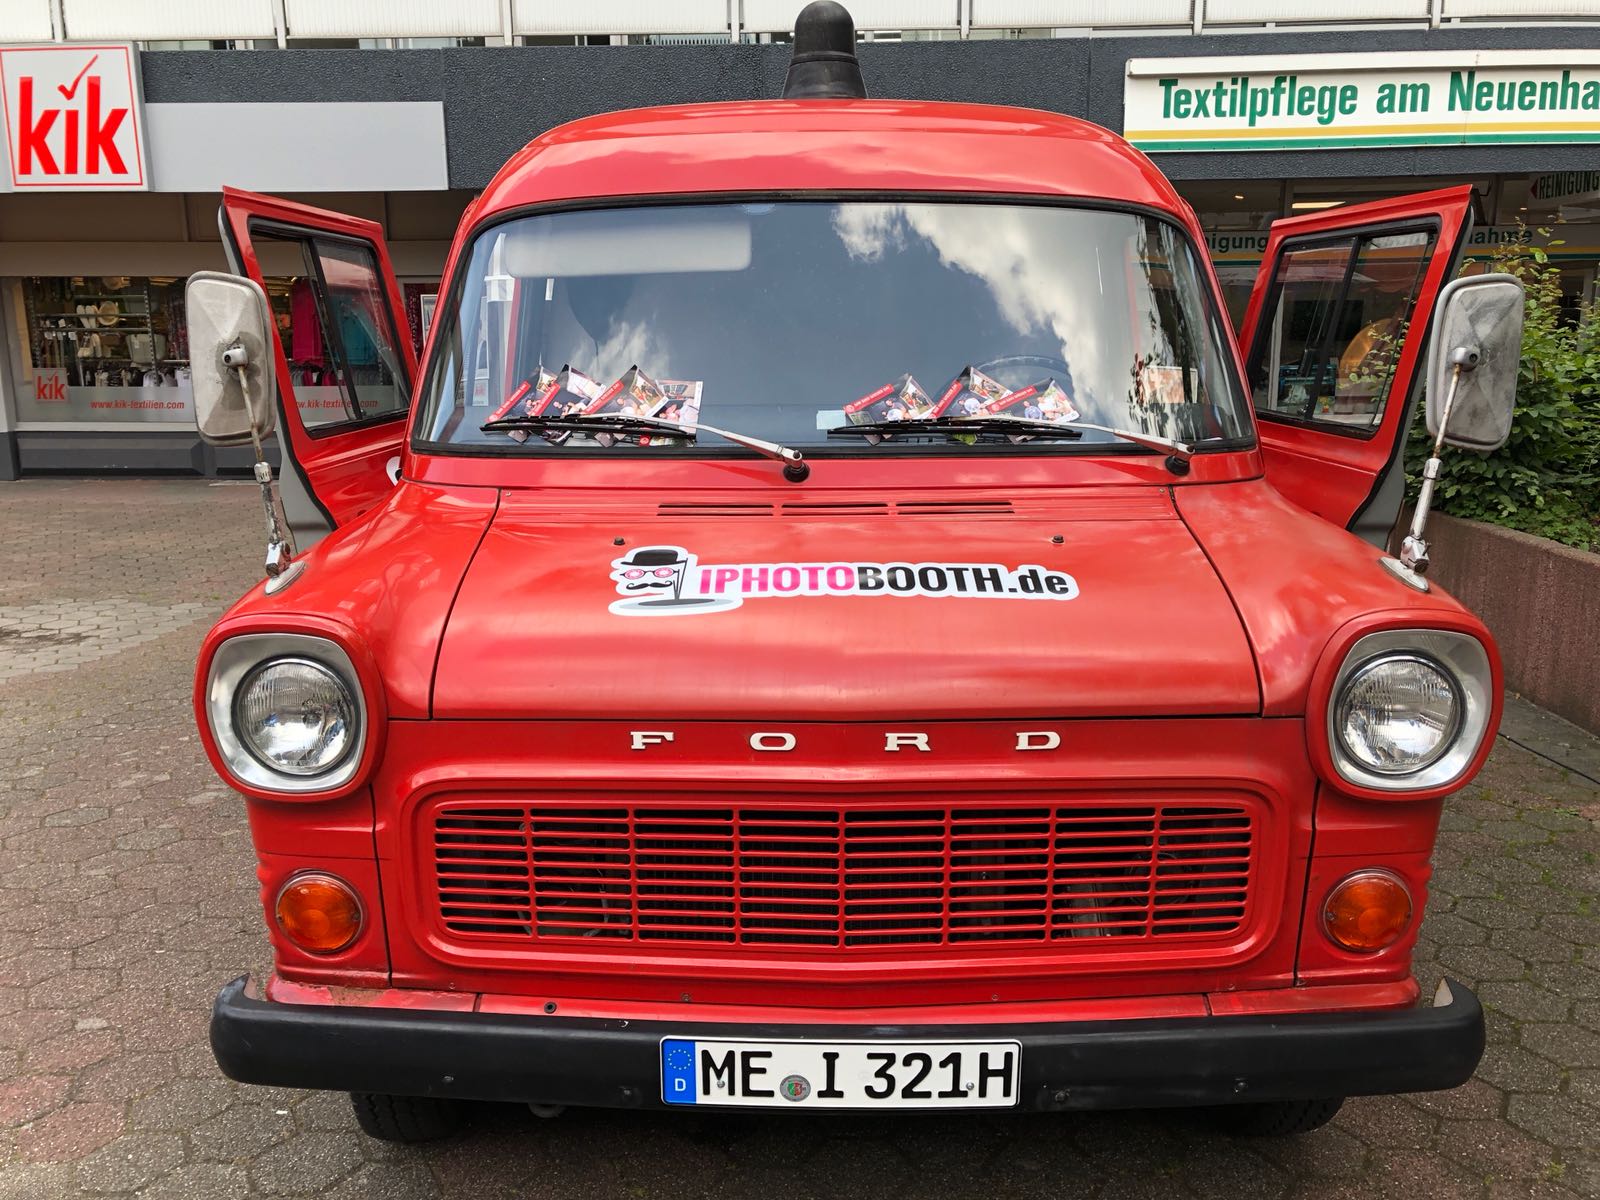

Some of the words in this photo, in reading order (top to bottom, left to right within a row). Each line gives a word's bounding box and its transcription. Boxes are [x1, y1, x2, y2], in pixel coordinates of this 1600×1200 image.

[18, 54, 129, 175] kik
[1158, 75, 1359, 127] Textilpflege
[1376, 82, 1431, 114] am
[1539, 171, 1600, 201] REINIGUNG
[36, 374, 66, 400] kik
[90, 400, 185, 410] www.kik-textilien.com
[699, 563, 1069, 595] IPHOTOBOOTH.de
[674, 1078, 686, 1092] D
[701, 1049, 775, 1098] ME
[864, 1051, 1014, 1099] 321H
